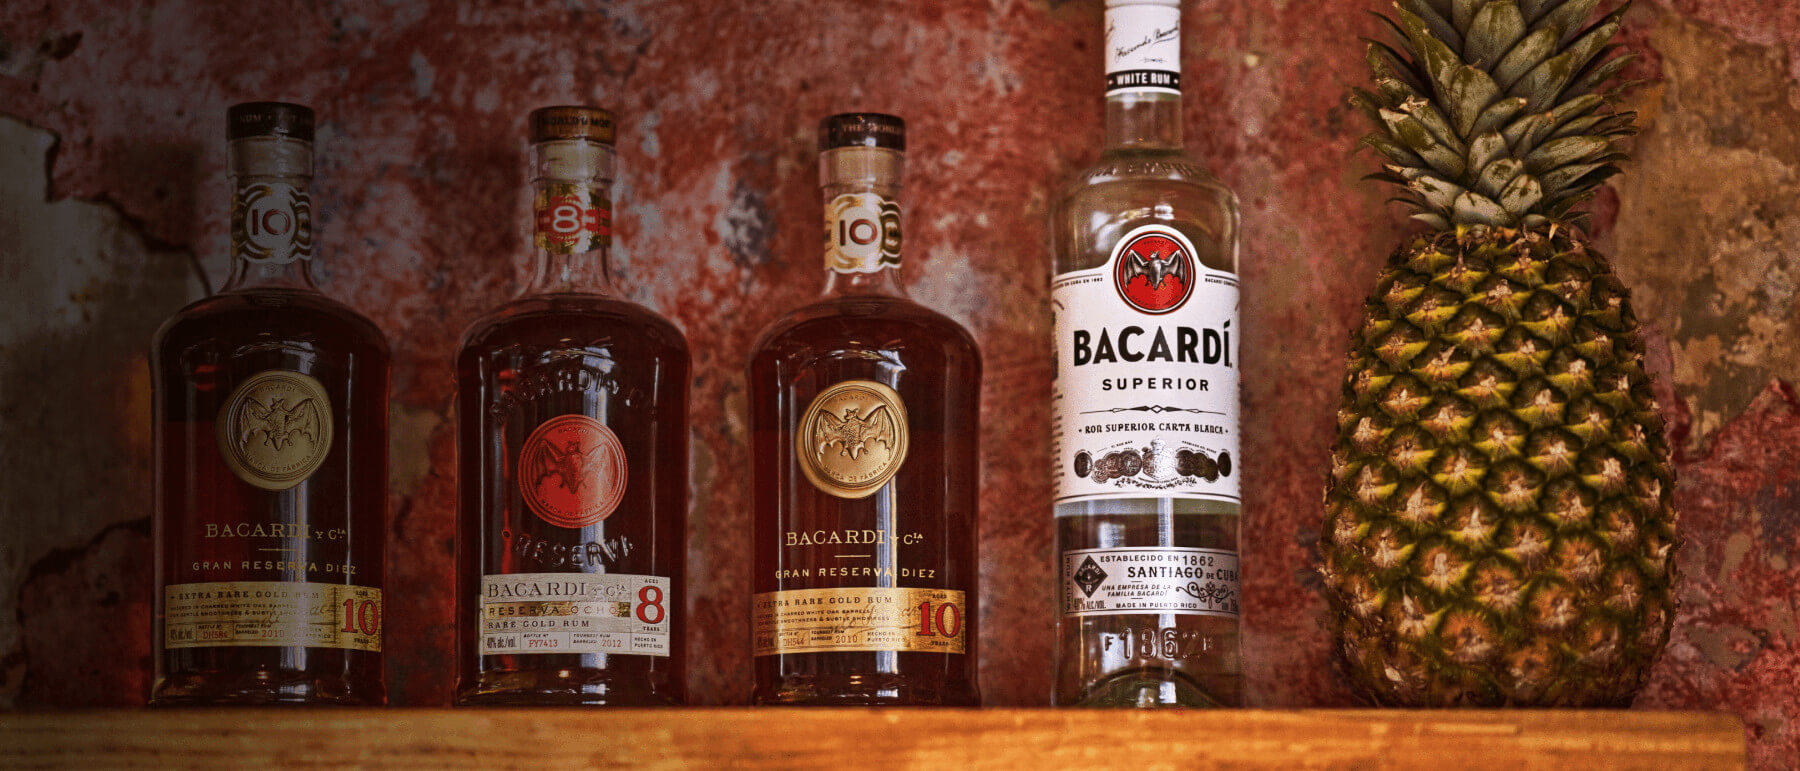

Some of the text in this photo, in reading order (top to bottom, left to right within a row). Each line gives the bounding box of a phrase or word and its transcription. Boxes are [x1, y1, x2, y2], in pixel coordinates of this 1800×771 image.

[1116, 72, 1171, 86] WHITE RUM
[251, 208, 292, 236] 10
[552, 204, 581, 233] 8
[839, 218, 878, 245] 10
[1073, 318, 1231, 368] BACARDÍ
[1102, 377, 1209, 391] SUPERIOR
[1085, 422, 1224, 435] RON SUPERIOR CARTA BLANCA
[205, 522, 312, 539] BACARDI
[785, 529, 887, 546] BACARDI
[1100, 554, 1214, 567] ESTABLECIDO EN 1862
[192, 560, 357, 576] GRAN RESERVA DIEZ
[775, 567, 936, 580] GRAN RESERVA DIEZ
[1127, 565, 1203, 579] SANTIAGO
[1206, 572, 1215, 580] DE
[488, 582, 586, 598] BACARDI
[1085, 584, 1093, 593] R
[1107, 590, 1135, 598] FAMILIA
[1117, 584, 1149, 592] EMPRESA
[178, 591, 212, 601] EXTRA
[217, 590, 250, 600] RARE
[254, 590, 288, 600] GOLD
[794, 597, 824, 606] RARE
[829, 596, 862, 605] GOLD
[867, 596, 892, 604] RUM
[489, 604, 617, 616] RESERVA OCHO
[635, 585, 665, 625] 8
[341, 598, 379, 637] 10
[916, 601, 961, 638] 10
[488, 620, 589, 629] RARE GOLD RUM
[261, 629, 284, 638] 2010
[834, 634, 858, 644] 2010
[528, 639, 559, 648] FY7413
[601, 639, 622, 648] 2012
